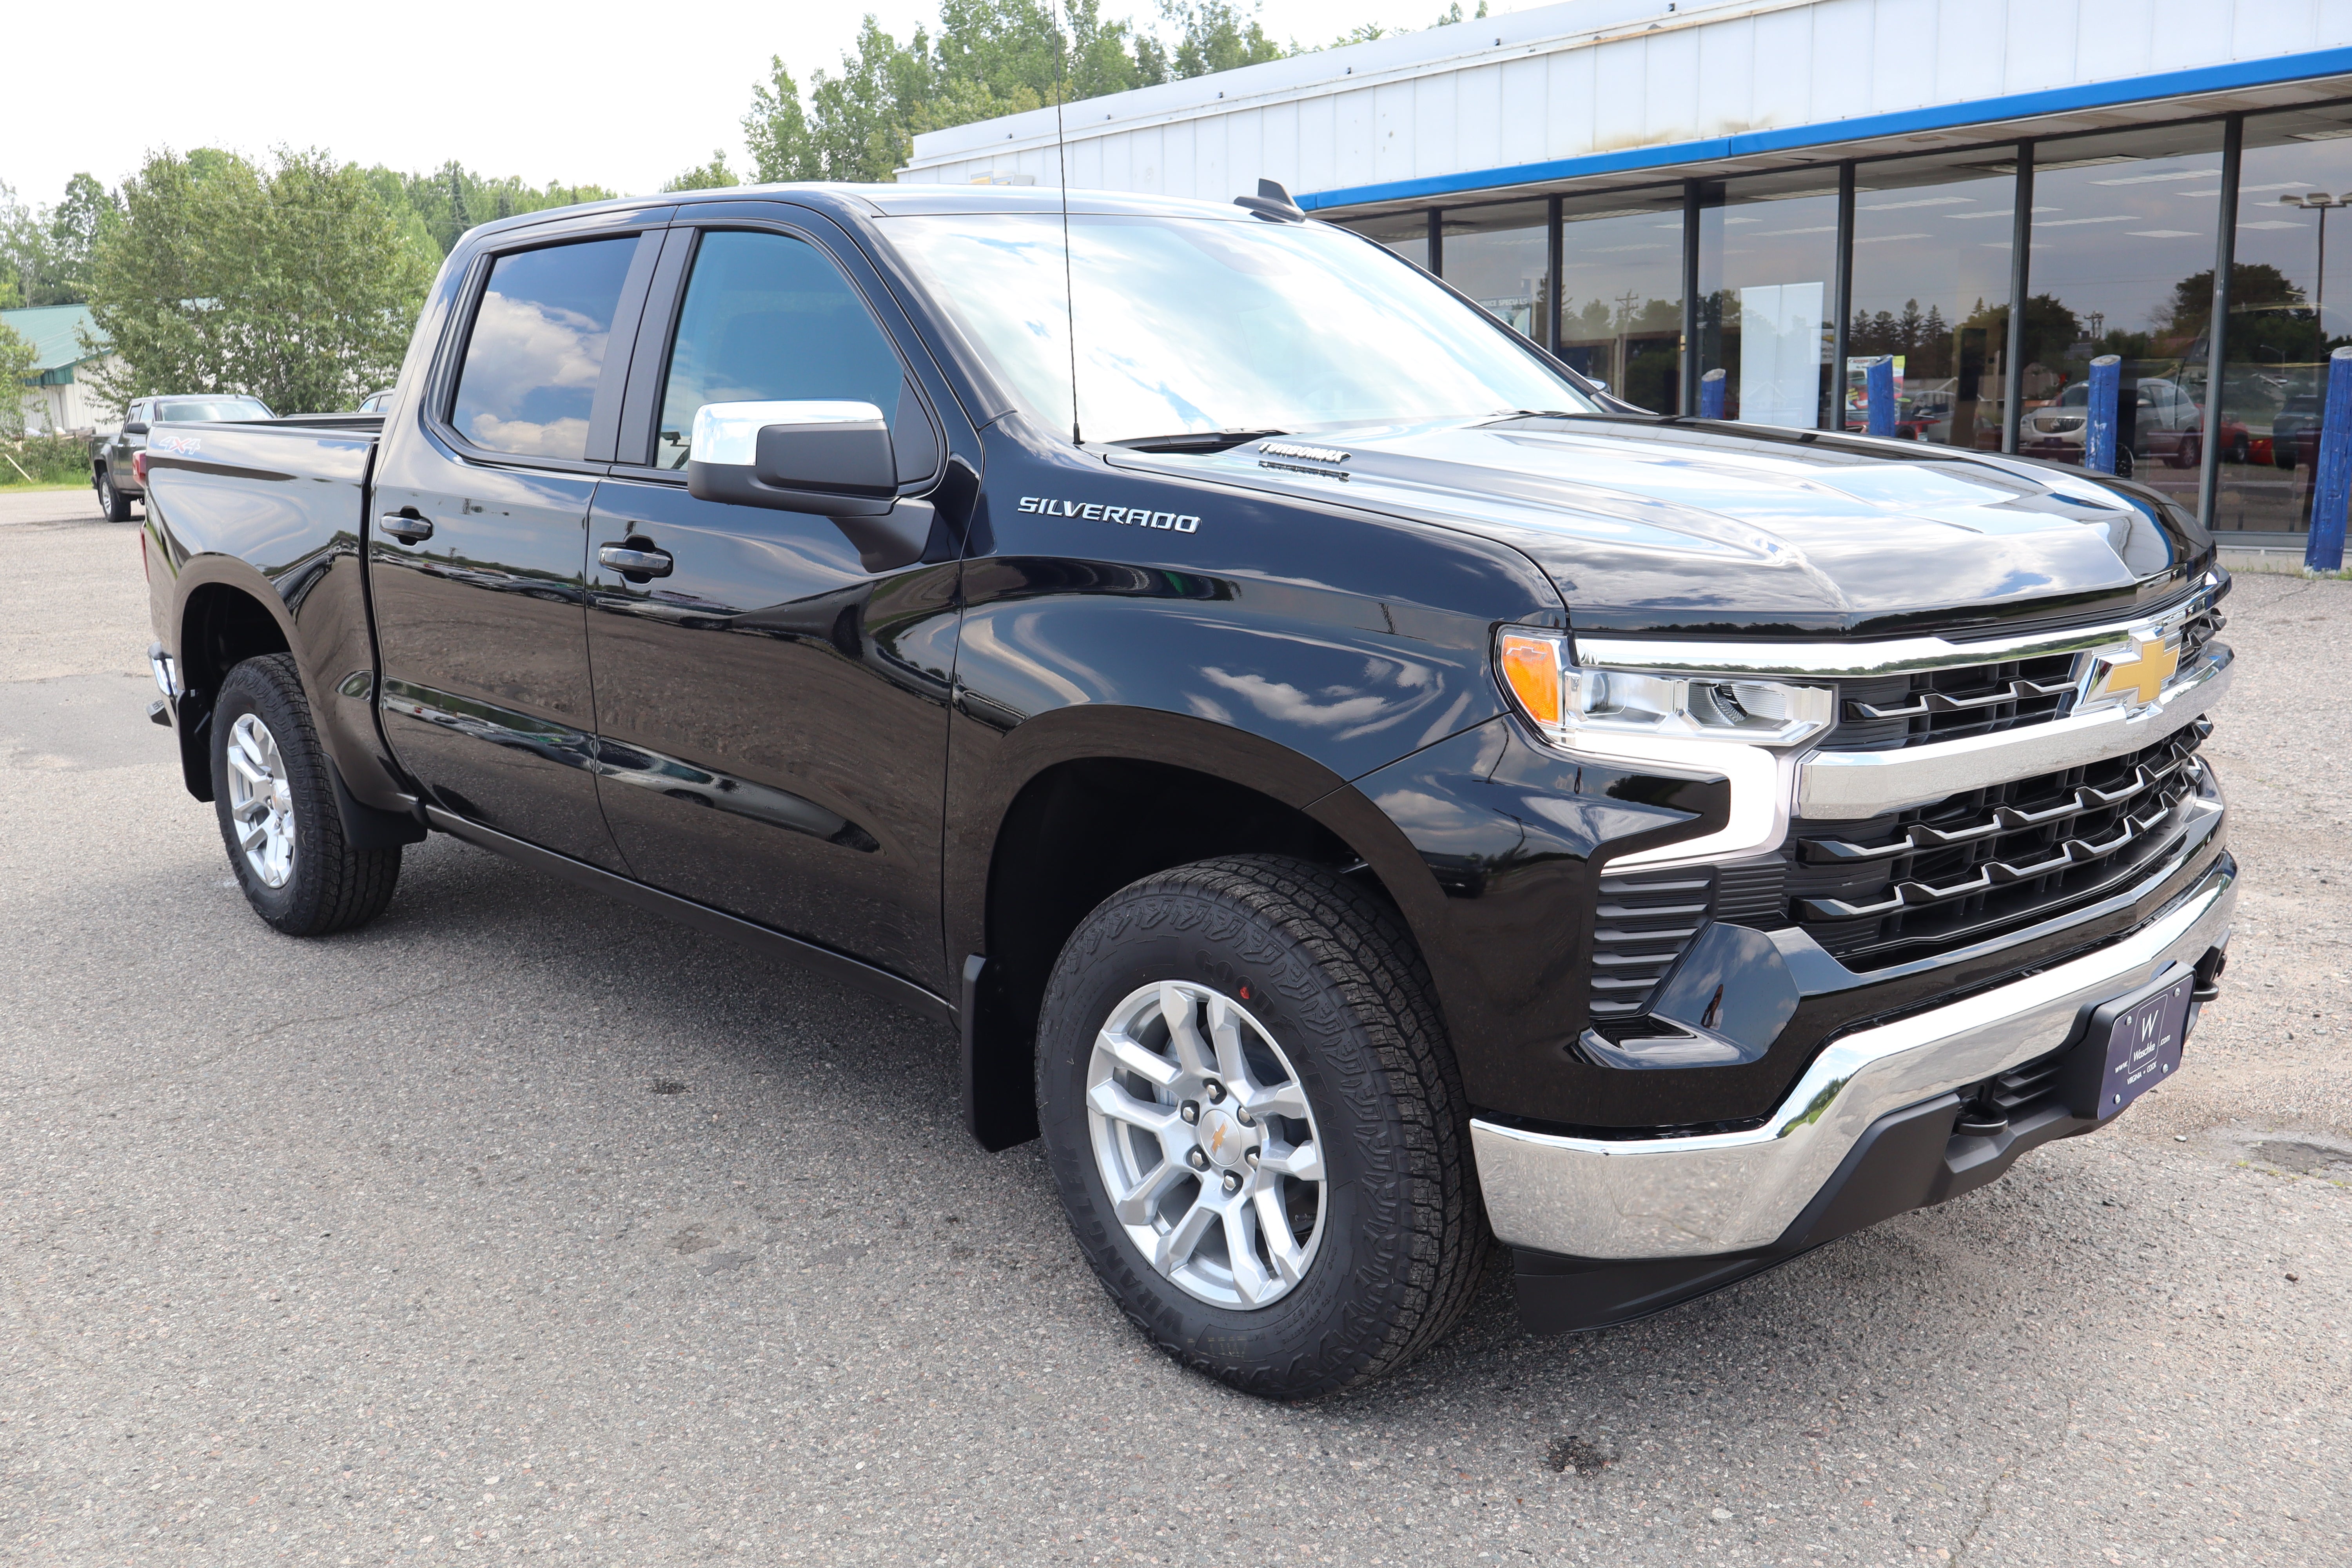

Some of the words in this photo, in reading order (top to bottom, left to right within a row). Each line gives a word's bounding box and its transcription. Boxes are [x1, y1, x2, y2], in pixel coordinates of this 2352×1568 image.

[1498, 298, 1528, 306] SPECIALS
[1258, 441, 1352, 463] TURBOMAX
[1018, 496, 1202, 534] SILVERADO
[2142, 1010, 2159, 1043] W
[2115, 1060, 2128, 1073] www.
[2134, 1041, 2156, 1062] Waschke
[2159, 1034, 2171, 1046] .com
[2127, 1071, 2142, 1085] VIRGINIA
[1059, 1144, 1184, 1336] WRANGLER
